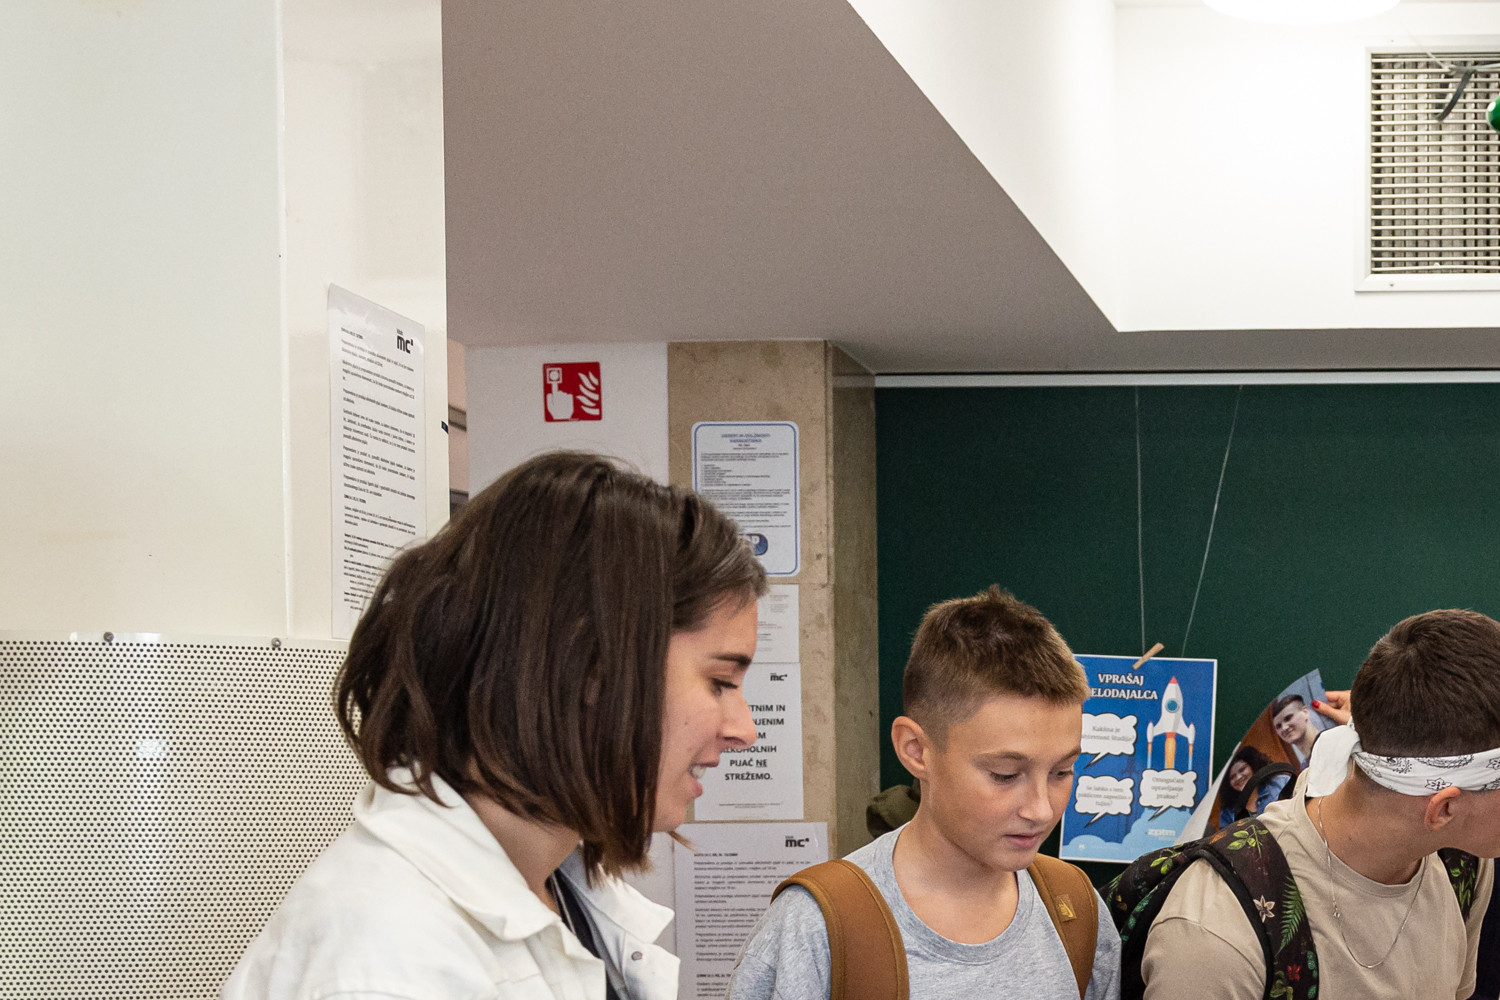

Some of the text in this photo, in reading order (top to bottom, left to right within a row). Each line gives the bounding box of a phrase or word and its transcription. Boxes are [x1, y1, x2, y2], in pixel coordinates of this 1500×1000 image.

[1097, 673, 1144, 687] VPRAŠAJ
[1091, 687, 1158, 700] ELODAJALCA
[756, 759, 767, 768] NE
